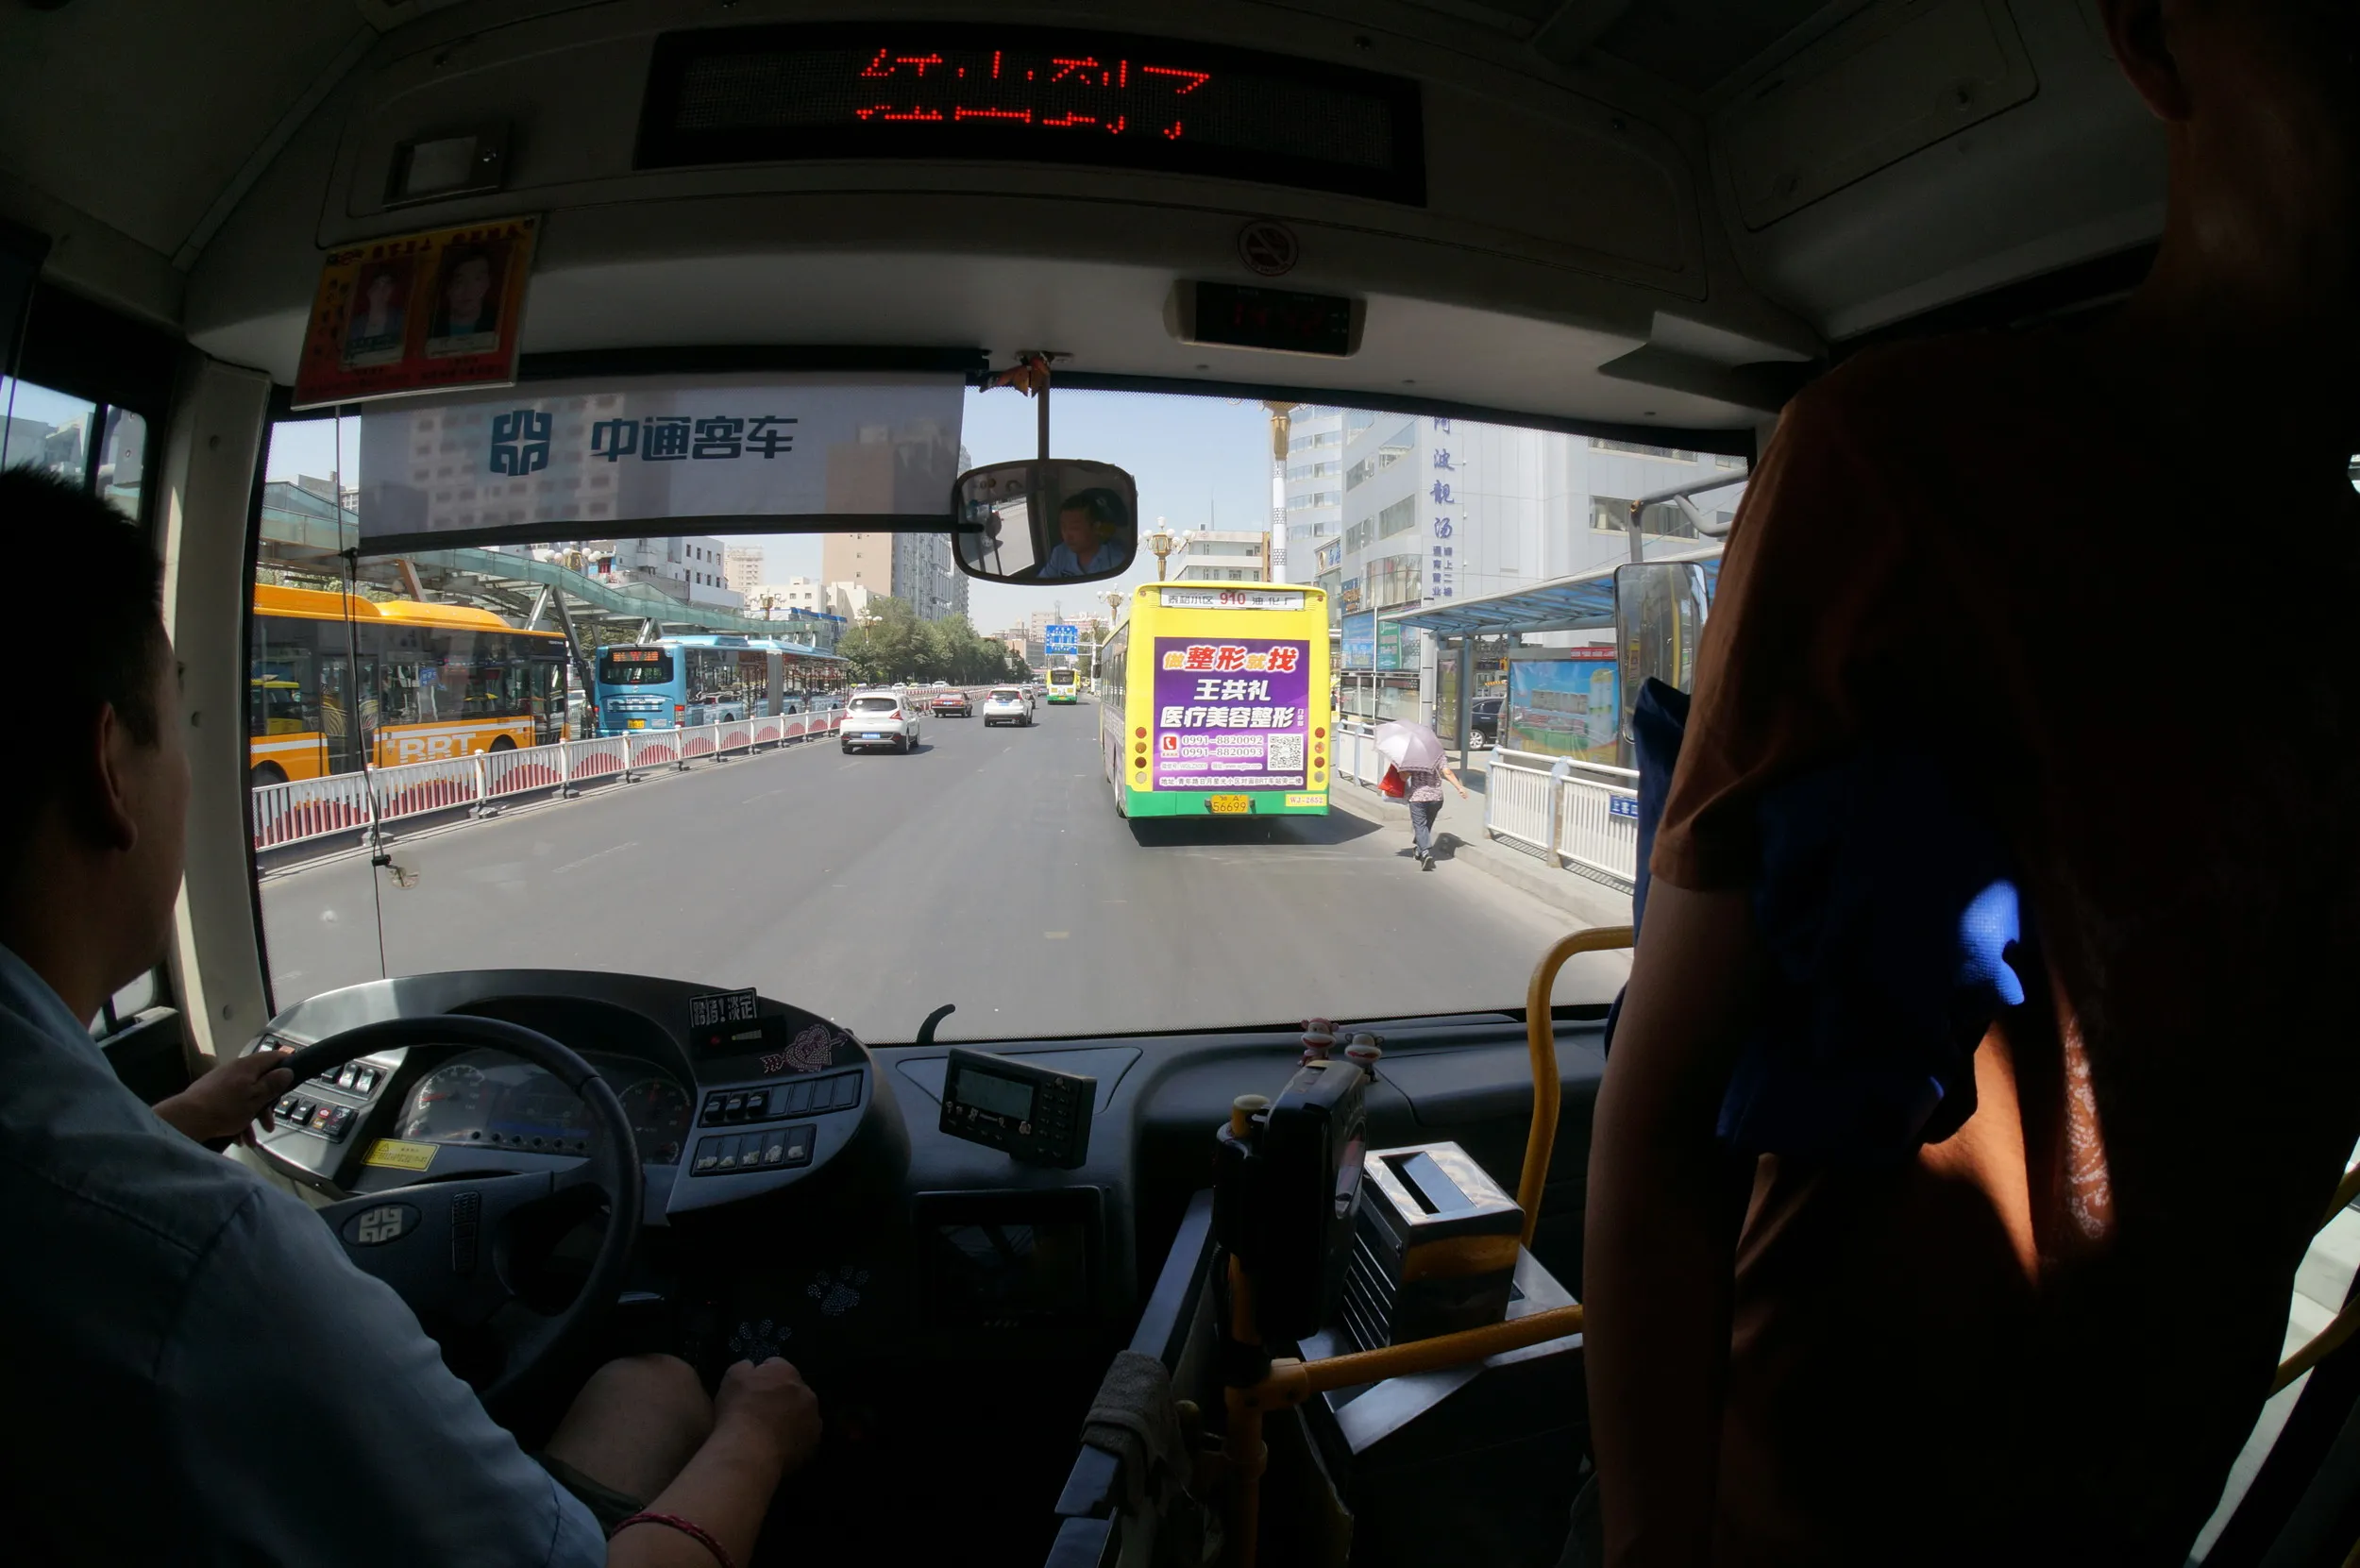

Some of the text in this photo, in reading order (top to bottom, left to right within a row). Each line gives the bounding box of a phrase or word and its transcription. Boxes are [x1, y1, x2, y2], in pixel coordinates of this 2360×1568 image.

[590, 414, 798, 463] 中通客车
[1220, 593, 1246, 605] 910
[1163, 646, 1298, 672] 做整形就找
[1193, 679, 1272, 701] 王共礼
[1160, 706, 1296, 729] 医疗美容整形
[399, 733, 477, 764] BRT
[1183, 735, 1263, 746] 0991-8820092
[1183, 747, 1263, 757] 0991-8820093
[1213, 801, 1247, 812] 56699
[1290, 796, 1323, 804] WJ-2652
